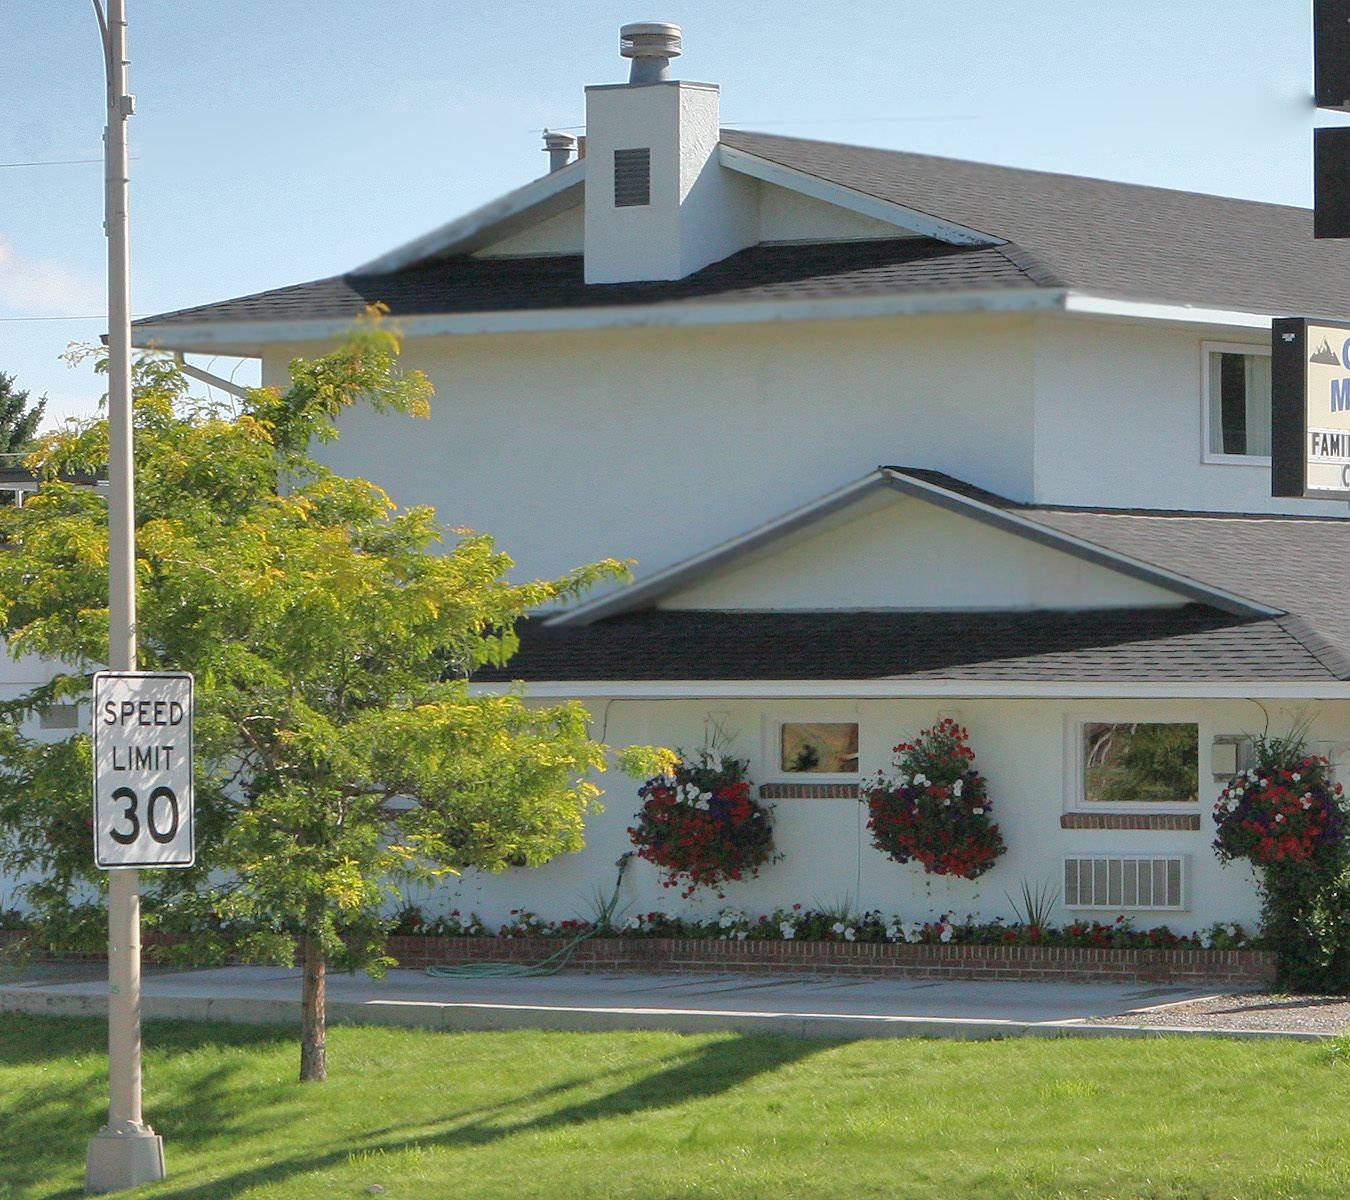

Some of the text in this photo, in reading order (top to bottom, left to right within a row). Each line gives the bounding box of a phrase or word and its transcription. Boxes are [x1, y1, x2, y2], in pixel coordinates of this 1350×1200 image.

[104, 701, 183, 726] SPEED
[113, 746, 174, 771] LIMIT
[109, 786, 179, 844] 30
